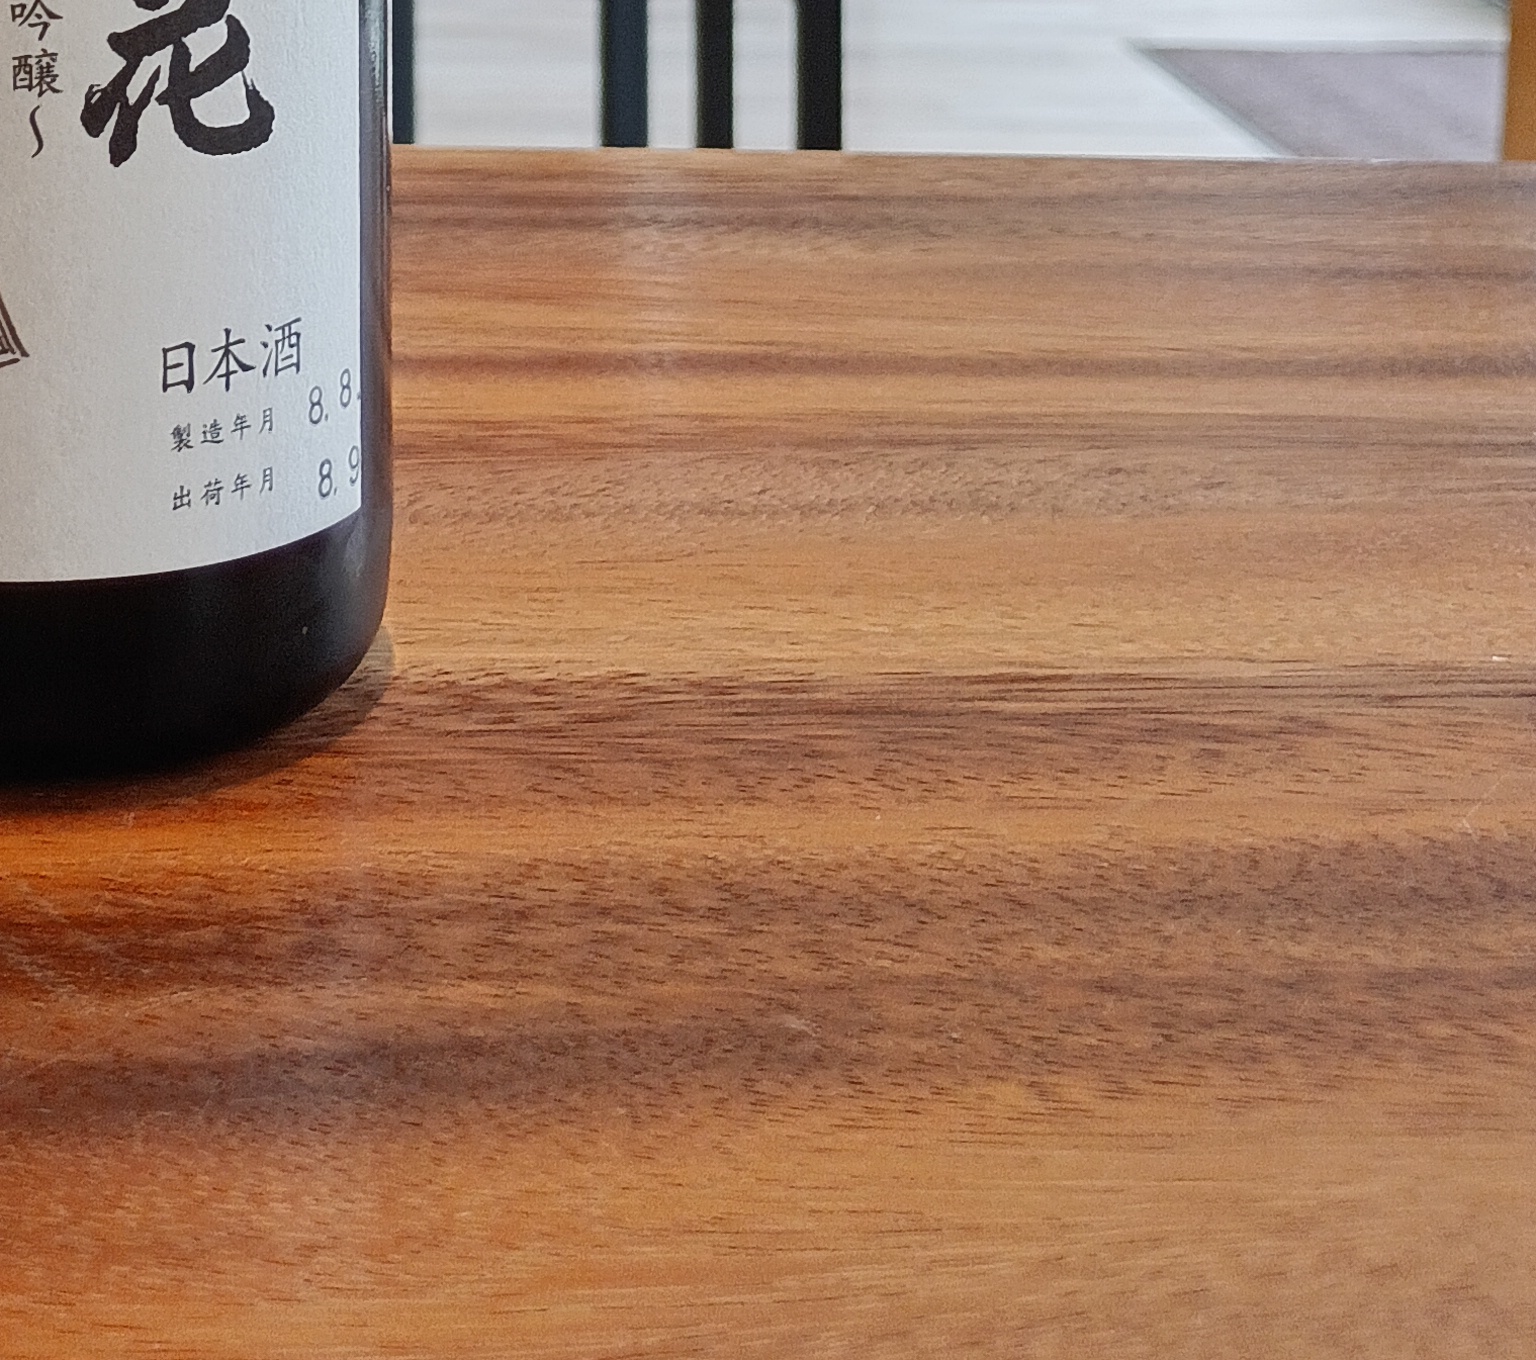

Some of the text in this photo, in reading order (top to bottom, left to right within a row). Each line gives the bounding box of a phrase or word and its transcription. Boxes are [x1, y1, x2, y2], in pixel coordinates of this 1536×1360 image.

[161, 317, 302, 394] 日本酒
[170, 407, 273, 453] 製造年月
[172, 467, 273, 511] 出荷年月
